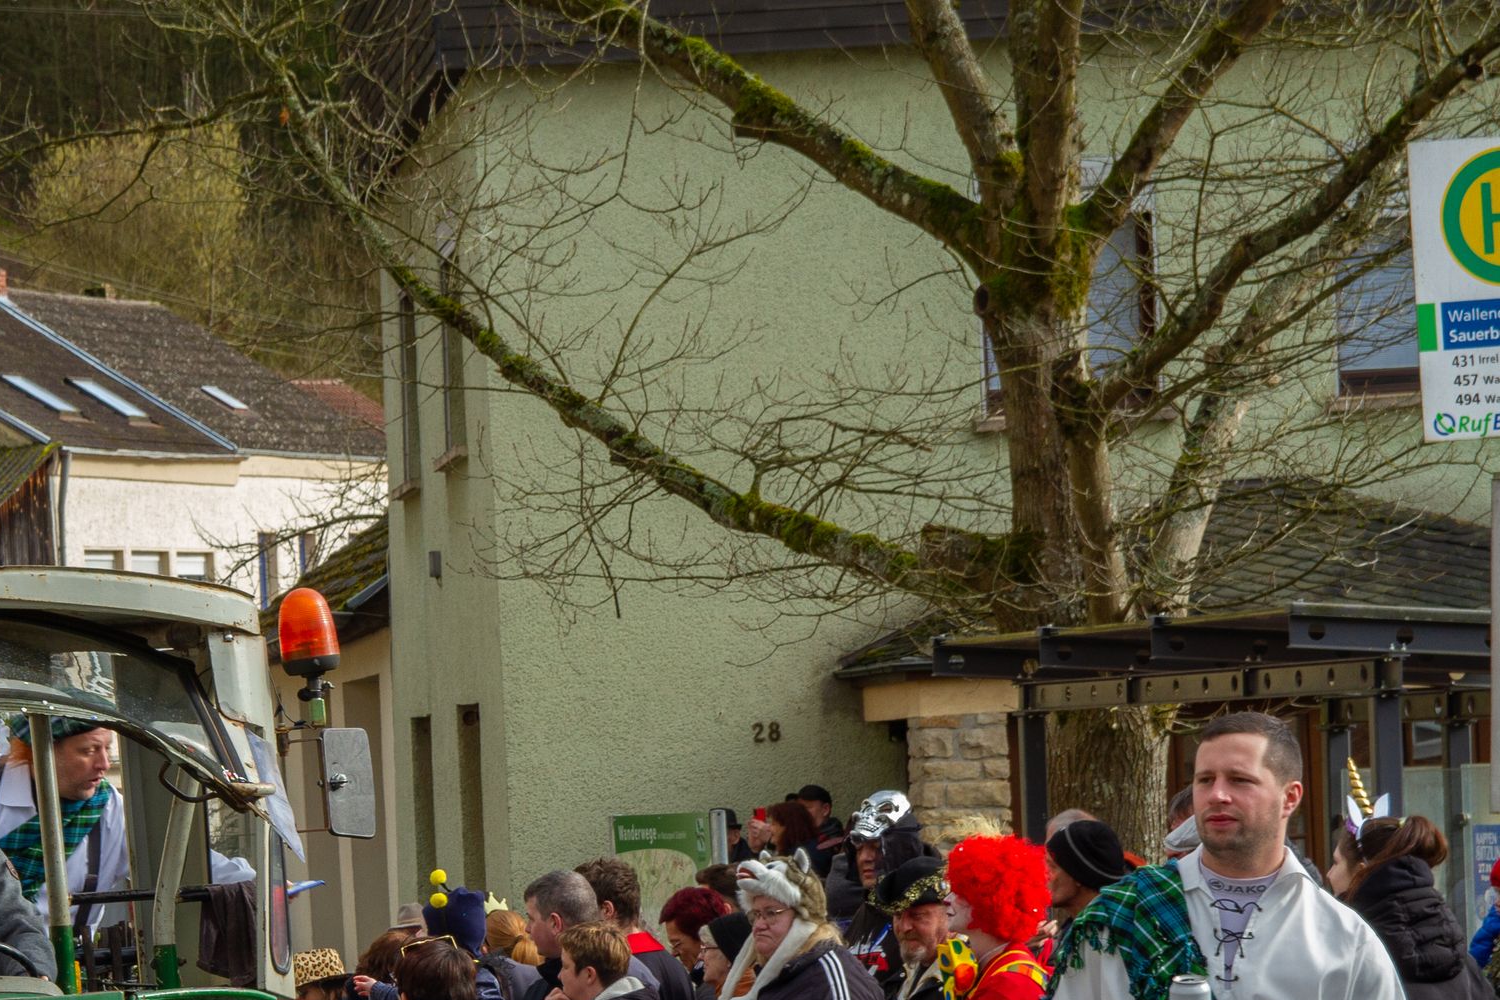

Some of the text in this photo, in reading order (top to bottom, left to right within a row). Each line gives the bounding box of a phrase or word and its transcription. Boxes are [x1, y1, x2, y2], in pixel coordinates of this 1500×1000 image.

[1448, 306, 1500, 323] Wallen
[1452, 353, 1499, 368] 431 Irrel
[1453, 374, 1478, 387] 457
[1455, 393, 1481, 406] 494
[752, 721, 781, 743] 28
[617, 823, 657, 845] Wanderwege
[1224, 884, 1267, 894] JAKO
